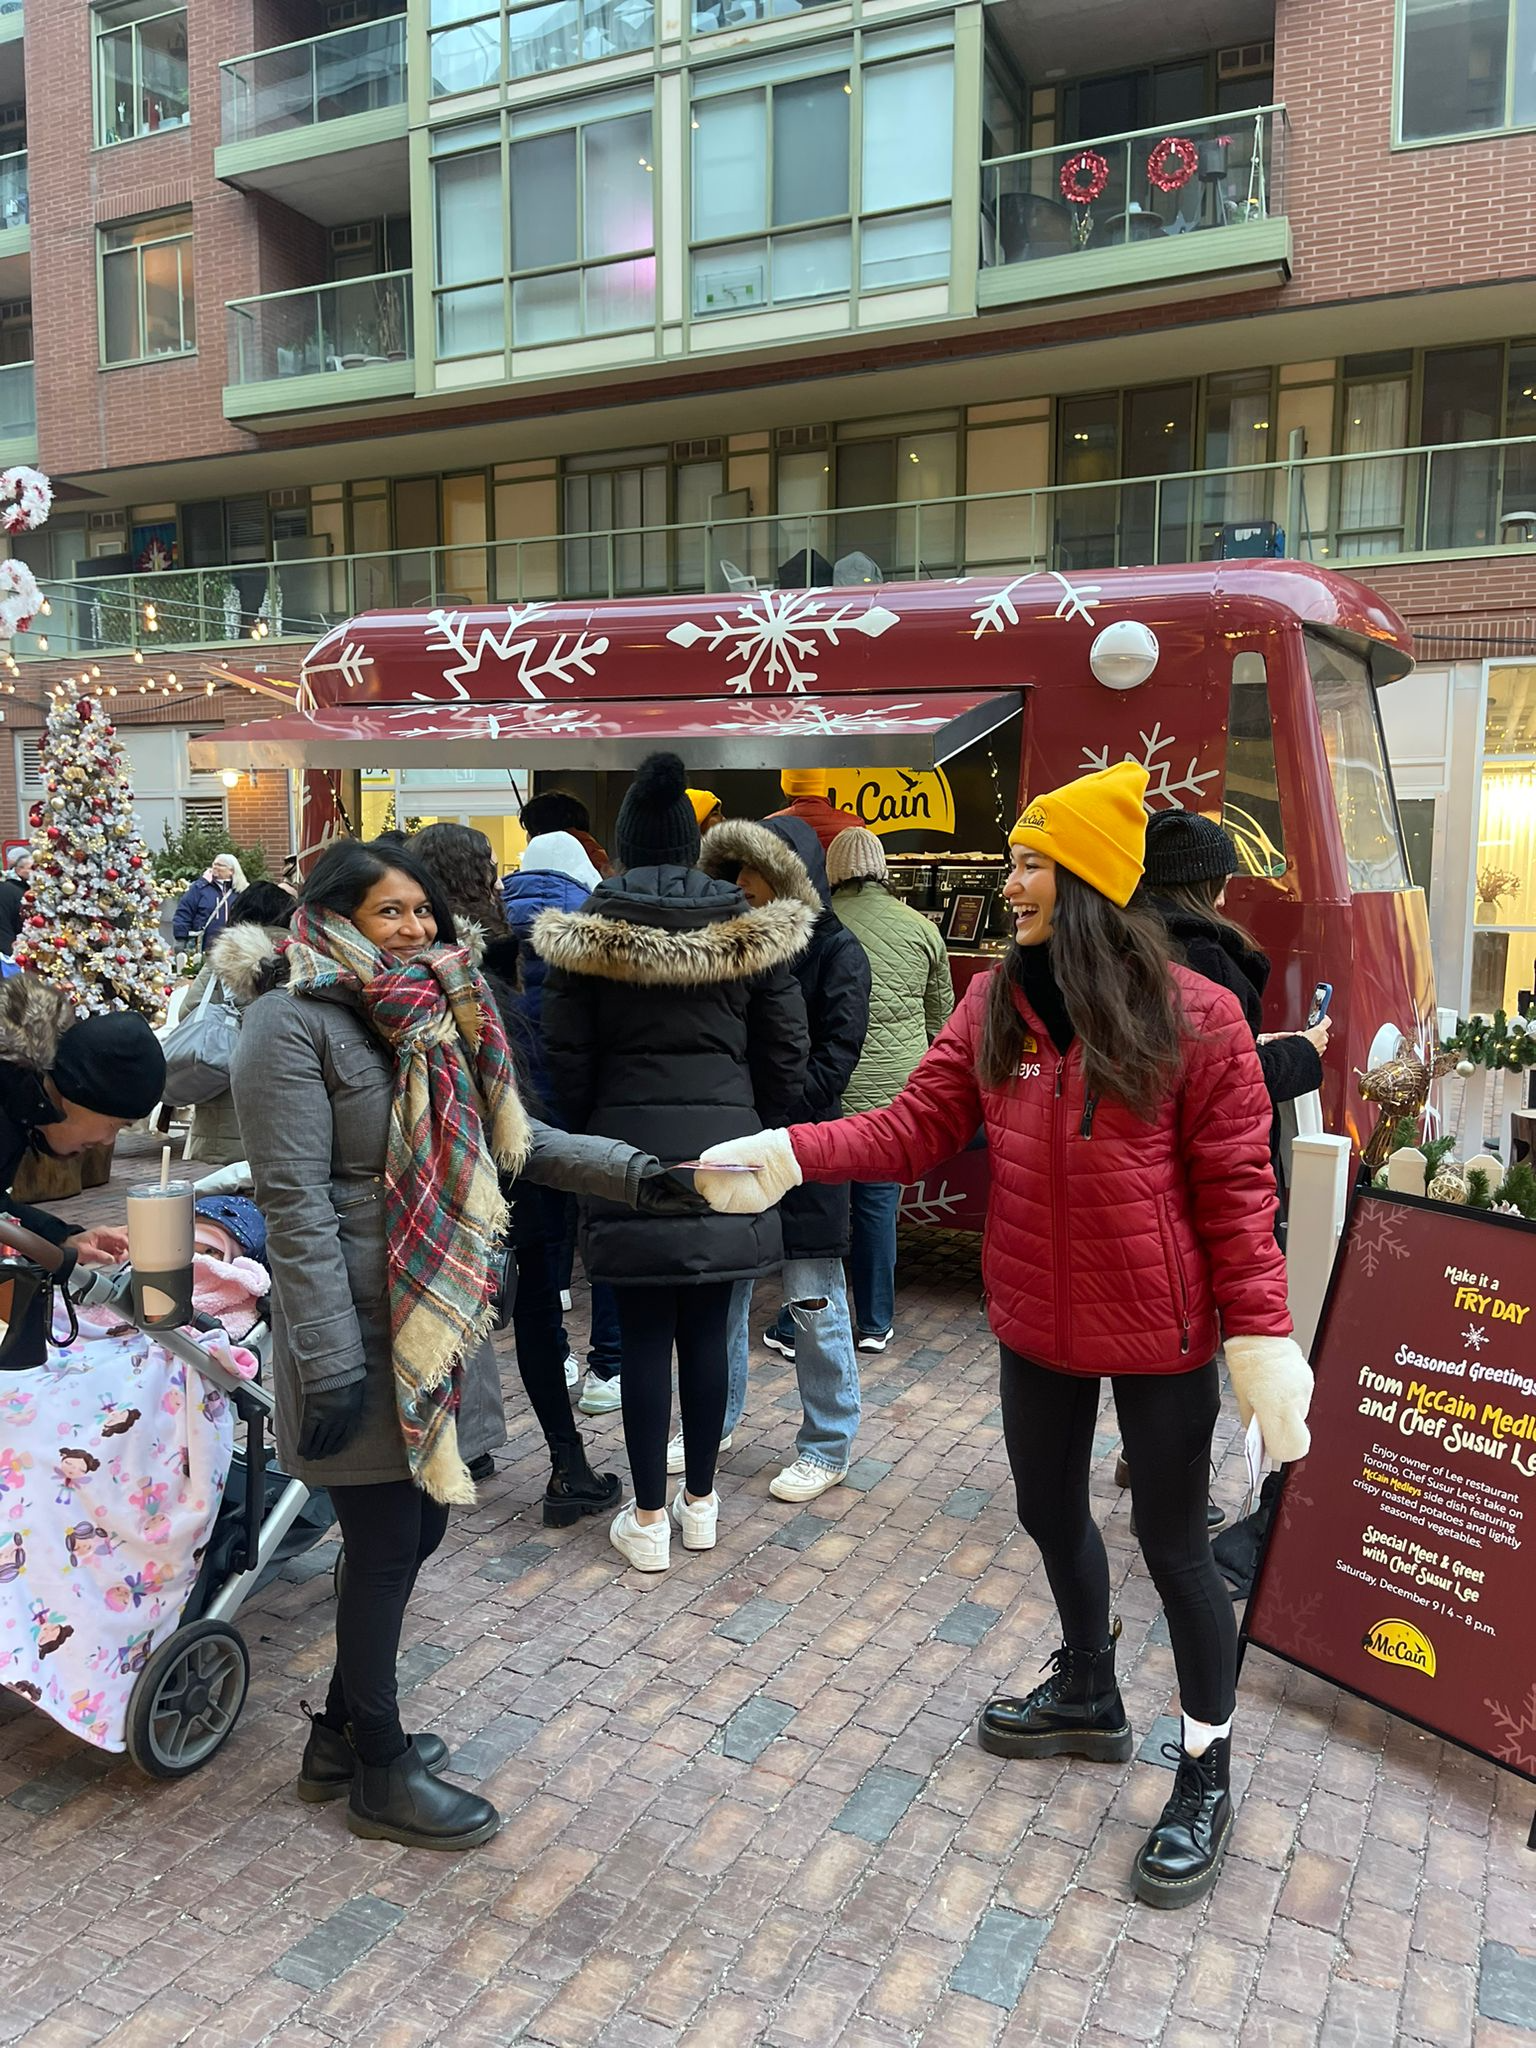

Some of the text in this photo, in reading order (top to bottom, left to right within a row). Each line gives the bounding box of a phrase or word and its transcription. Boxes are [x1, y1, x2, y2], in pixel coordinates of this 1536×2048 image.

[1444, 1266, 1500, 1290] Make it a
[1454, 1286, 1530, 1324] FRY DAY
[1394, 1344, 1467, 1376] Seasoned
[1358, 1366, 1403, 1396] from
[1406, 1380, 1476, 1414] McCain
[1358, 1397, 1398, 1424] and
[1399, 1408, 1447, 1438] Chef
[1443, 1422, 1508, 1460] Susur
[1362, 1467, 1516, 1534] McCain Medleys side dish featuring
[1363, 1453, 1400, 1476] Toronto,
[1402, 1468, 1426, 1484] Chef
[1427, 1476, 1455, 1494] Susur
[1484, 1498, 1506, 1514] take
[1508, 1508, 1524, 1520] on
[1372, 1443, 1520, 1504] Enjoy owner of Lee restaurant
[1352, 1478, 1522, 1550] crispy roasted potatoes and lightly
[1380, 1502, 1482, 1549] seasoned vegetables.
[1362, 1525, 1486, 1584] Special Meet & Greet
[1362, 1545, 1480, 1603] with Chef Susur Lee
[1336, 1559, 1377, 1586] Saturday,
[1380, 1578, 1430, 1608] December
[1432, 1600, 1440, 1610] 9
[1446, 1608, 1454, 1618] 4
[1464, 1614, 1473, 1626] 8
[1473, 1620, 1496, 1636] p.m.
[1371, 1633, 1426, 1667] McCain
